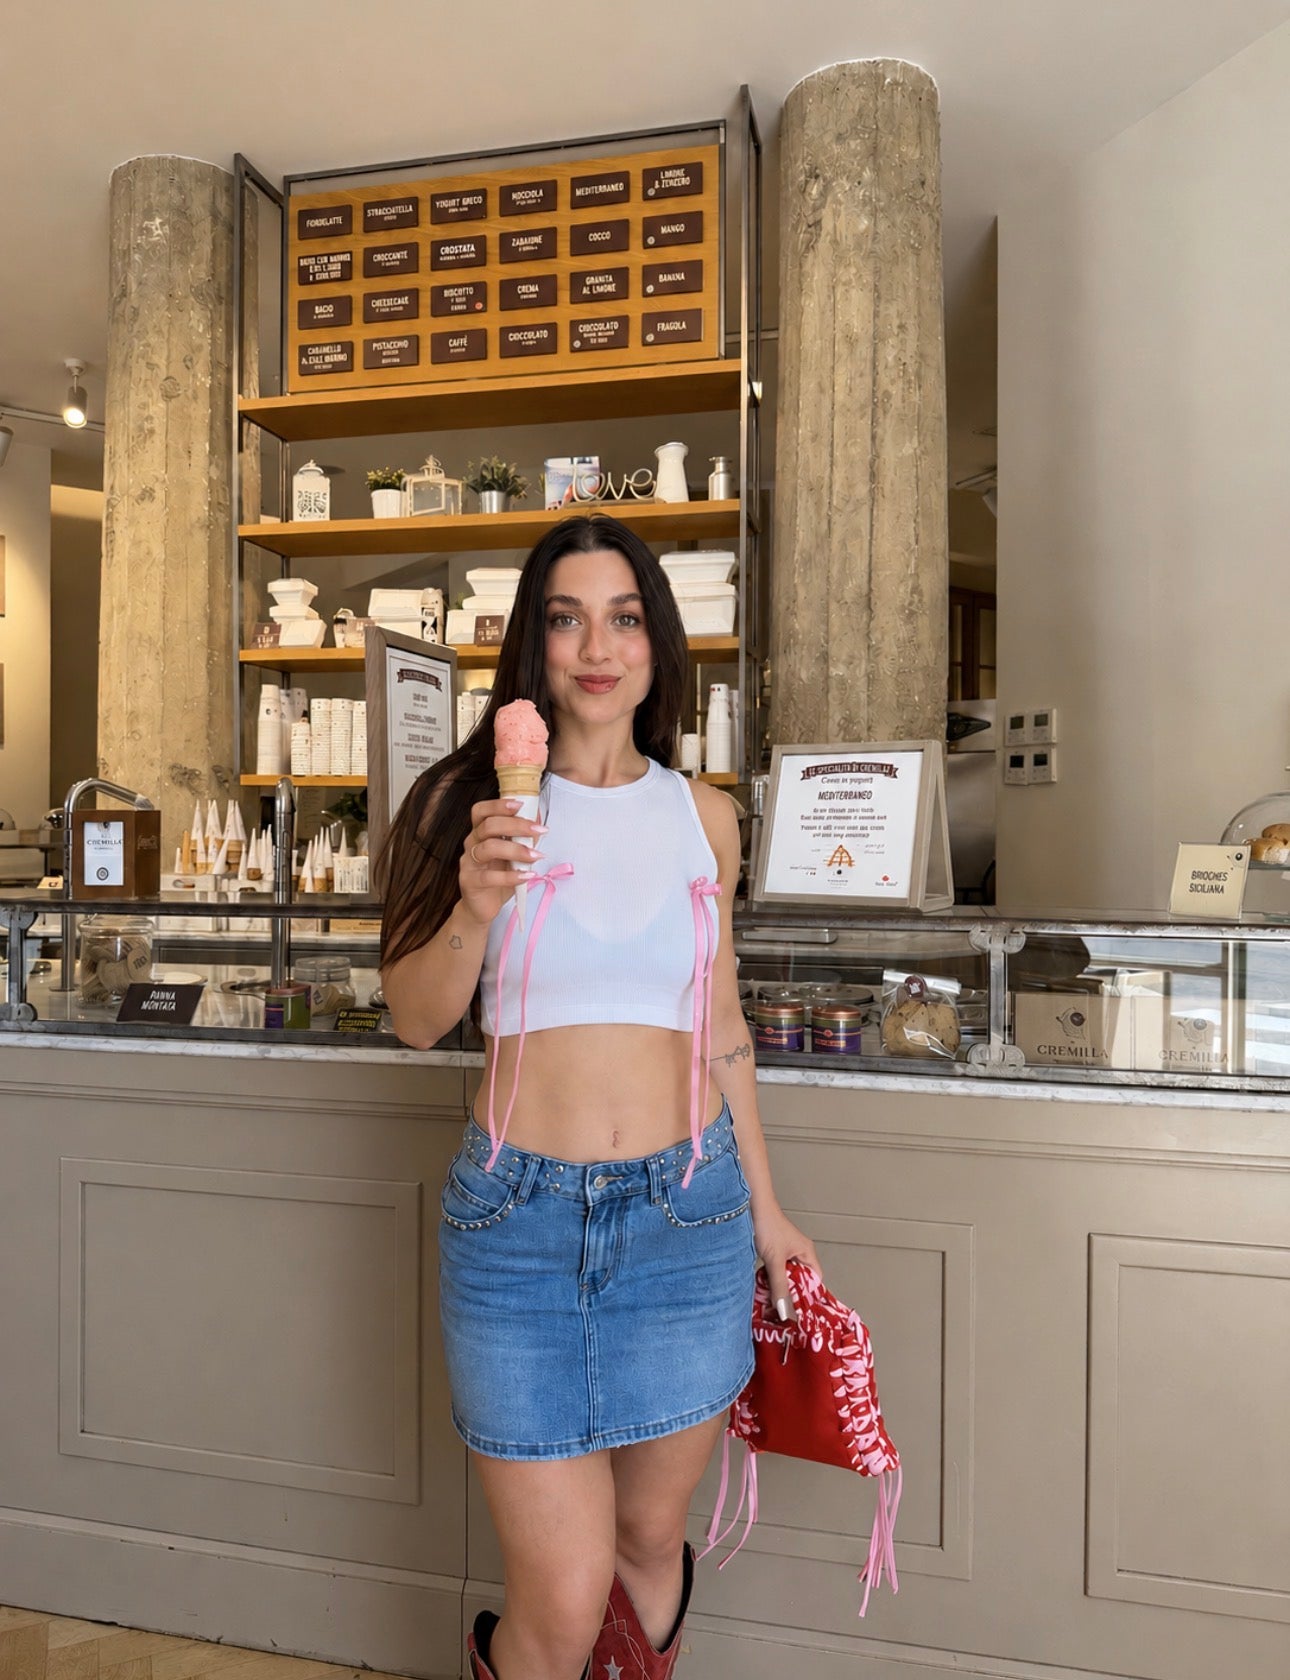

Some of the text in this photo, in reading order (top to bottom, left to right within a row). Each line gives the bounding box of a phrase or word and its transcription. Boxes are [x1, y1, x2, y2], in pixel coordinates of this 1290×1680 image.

[575, 182, 625, 196] MEDITERRANEO
[661, 223, 685, 234] MANGO
[588, 231, 612, 242] COCCO
[440, 244, 476, 256] CROSTATA
[372, 250, 409, 262] CROCCANTE
[585, 274, 613, 285] GRANITA
[658, 272, 686, 283] BANANA
[517, 284, 540, 294] CREMA
[657, 321, 687, 332] FRAGOLA
[818, 790, 873, 800] MEDITERRANEO
[1190, 870, 1229, 881] BRIOCHES
[1188, 883, 1225, 894] SICILIANA
[1037, 1044, 1108, 1059] CREMILLA
